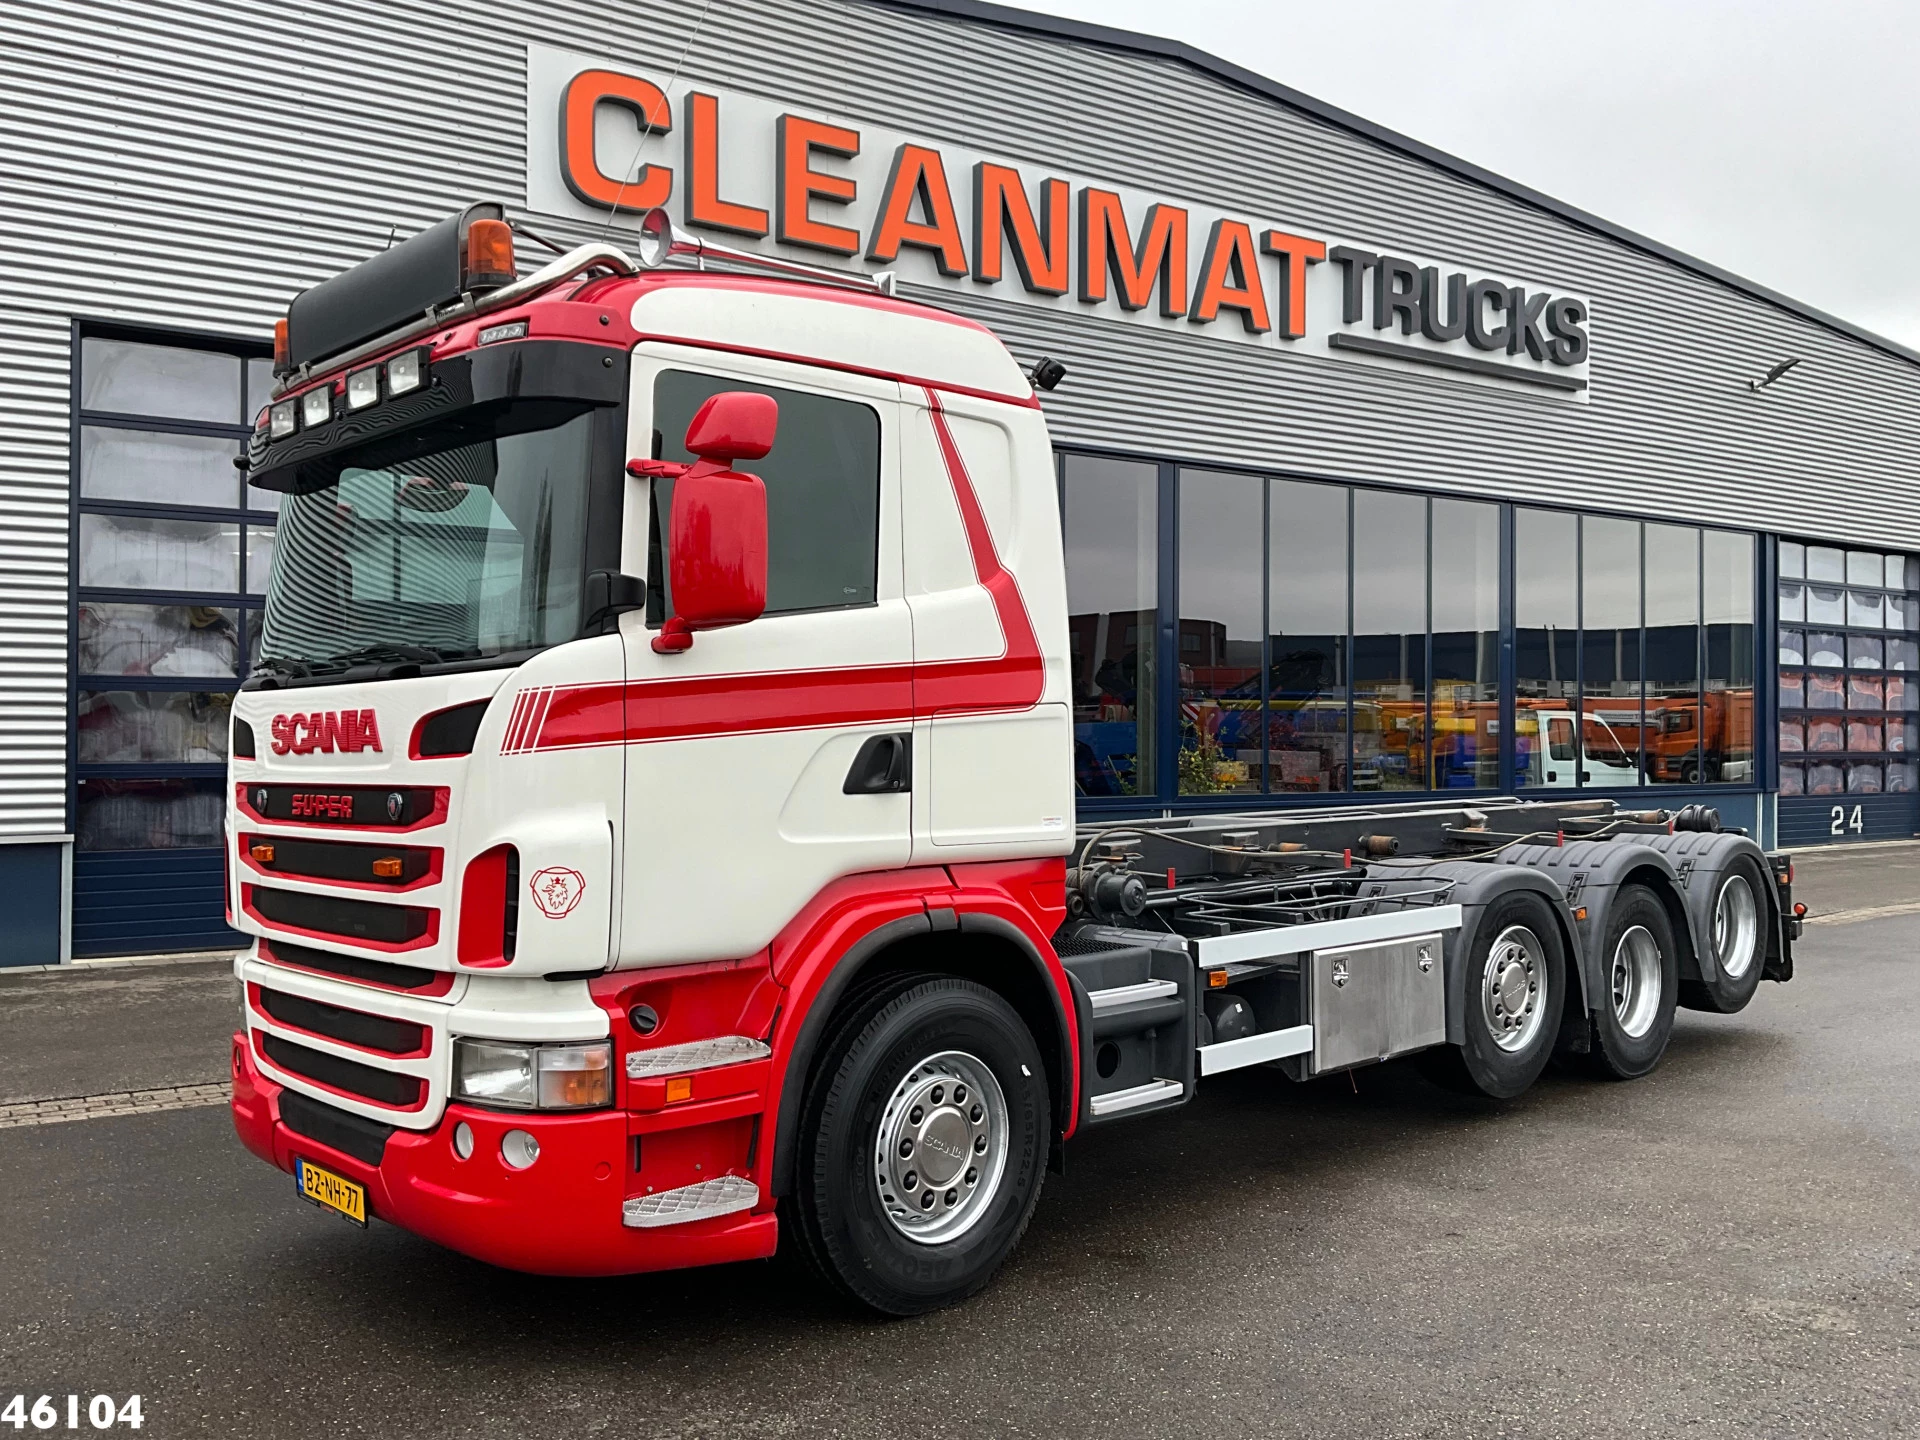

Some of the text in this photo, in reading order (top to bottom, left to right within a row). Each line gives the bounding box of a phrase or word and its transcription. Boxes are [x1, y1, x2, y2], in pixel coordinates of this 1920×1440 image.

[558, 68, 1588, 366] CLEANMAT TRUCKS
[271, 708, 383, 756] SCANIA
[291, 793, 353, 818] SUPER
[1831, 804, 1864, 835] 24
[924, 1135, 964, 1161] SCANIA
[305, 1167, 358, 1213] BZ-NH-77
